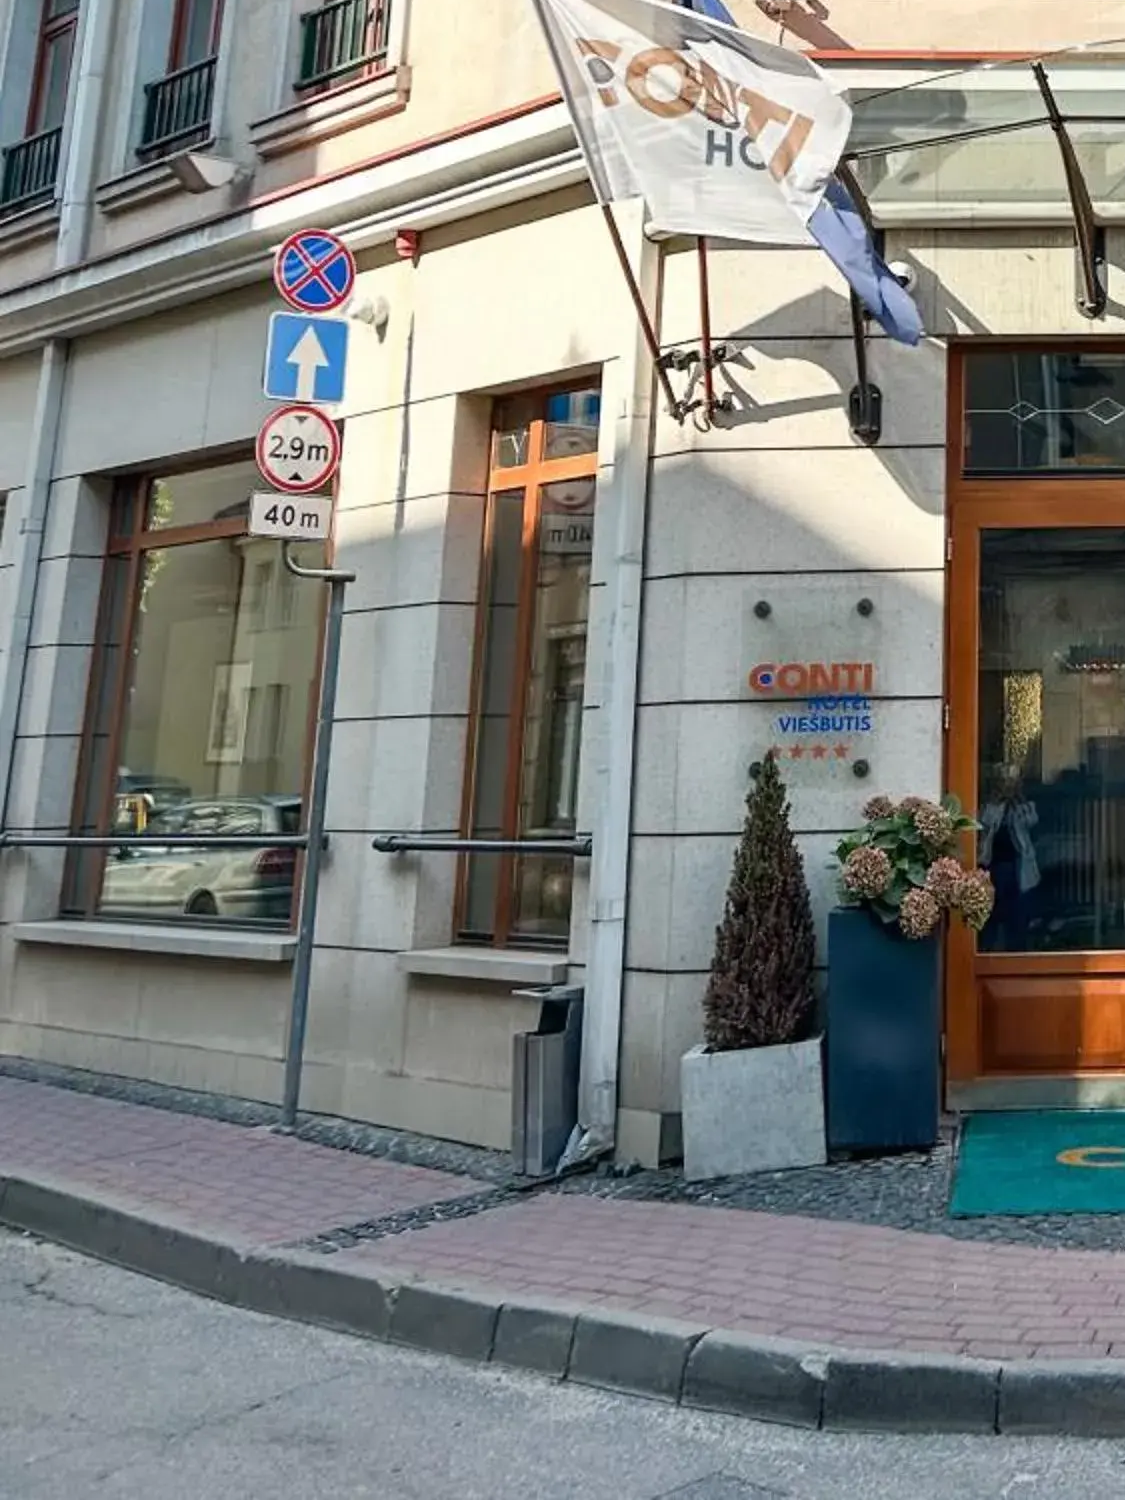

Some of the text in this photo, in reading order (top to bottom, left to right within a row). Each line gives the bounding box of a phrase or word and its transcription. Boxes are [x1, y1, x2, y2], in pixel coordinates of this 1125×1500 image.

[264, 504, 319, 529] 40 m
[749, 663, 873, 694] CONTI
[807, 694, 871, 710] HOTEL
